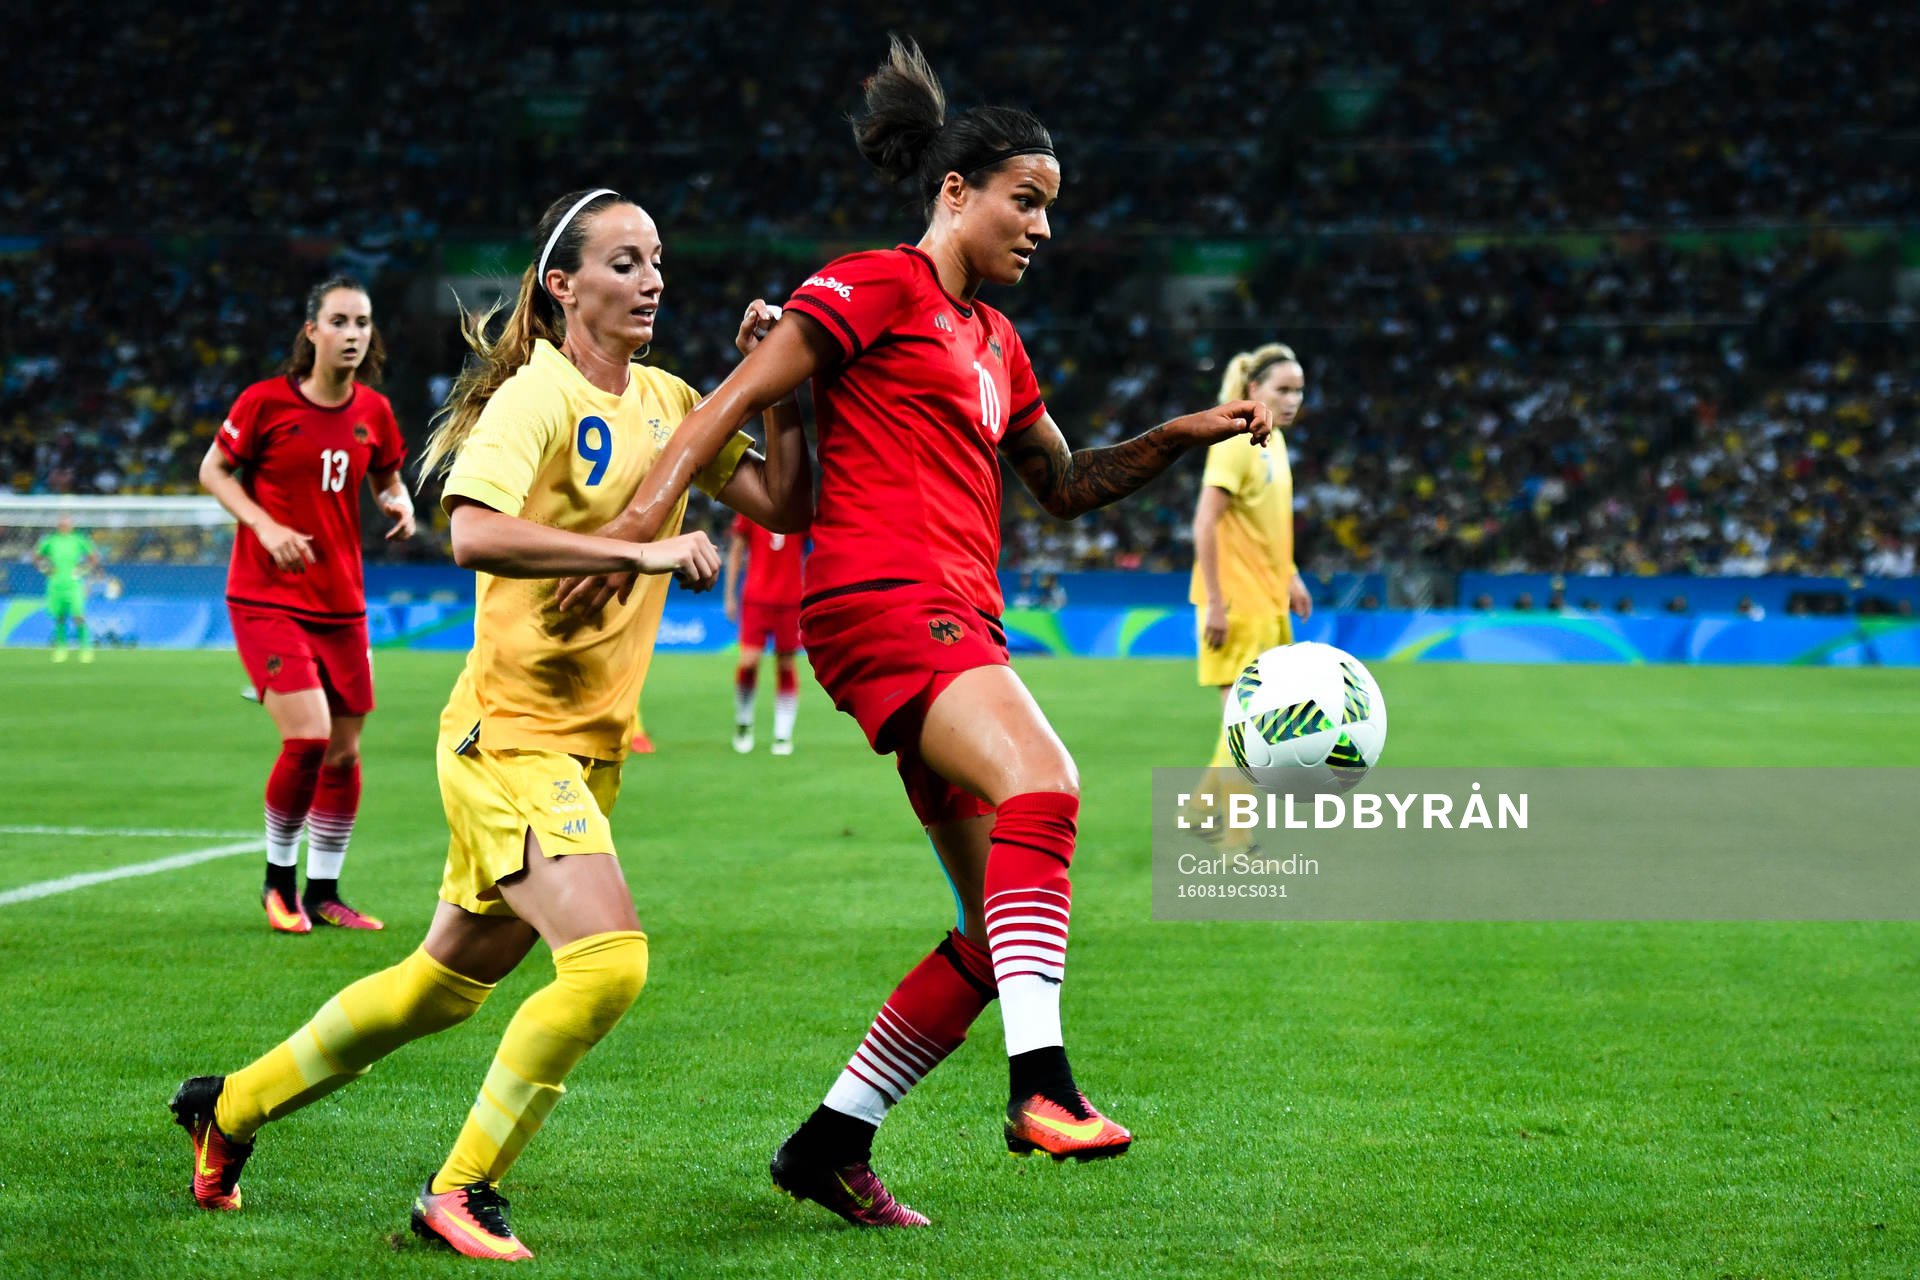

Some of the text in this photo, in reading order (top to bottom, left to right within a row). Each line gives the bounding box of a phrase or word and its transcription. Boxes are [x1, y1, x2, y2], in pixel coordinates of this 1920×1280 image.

[973, 360, 1001, 435] 10
[320, 448, 350, 493] 13
[577, 415, 612, 486] 9
